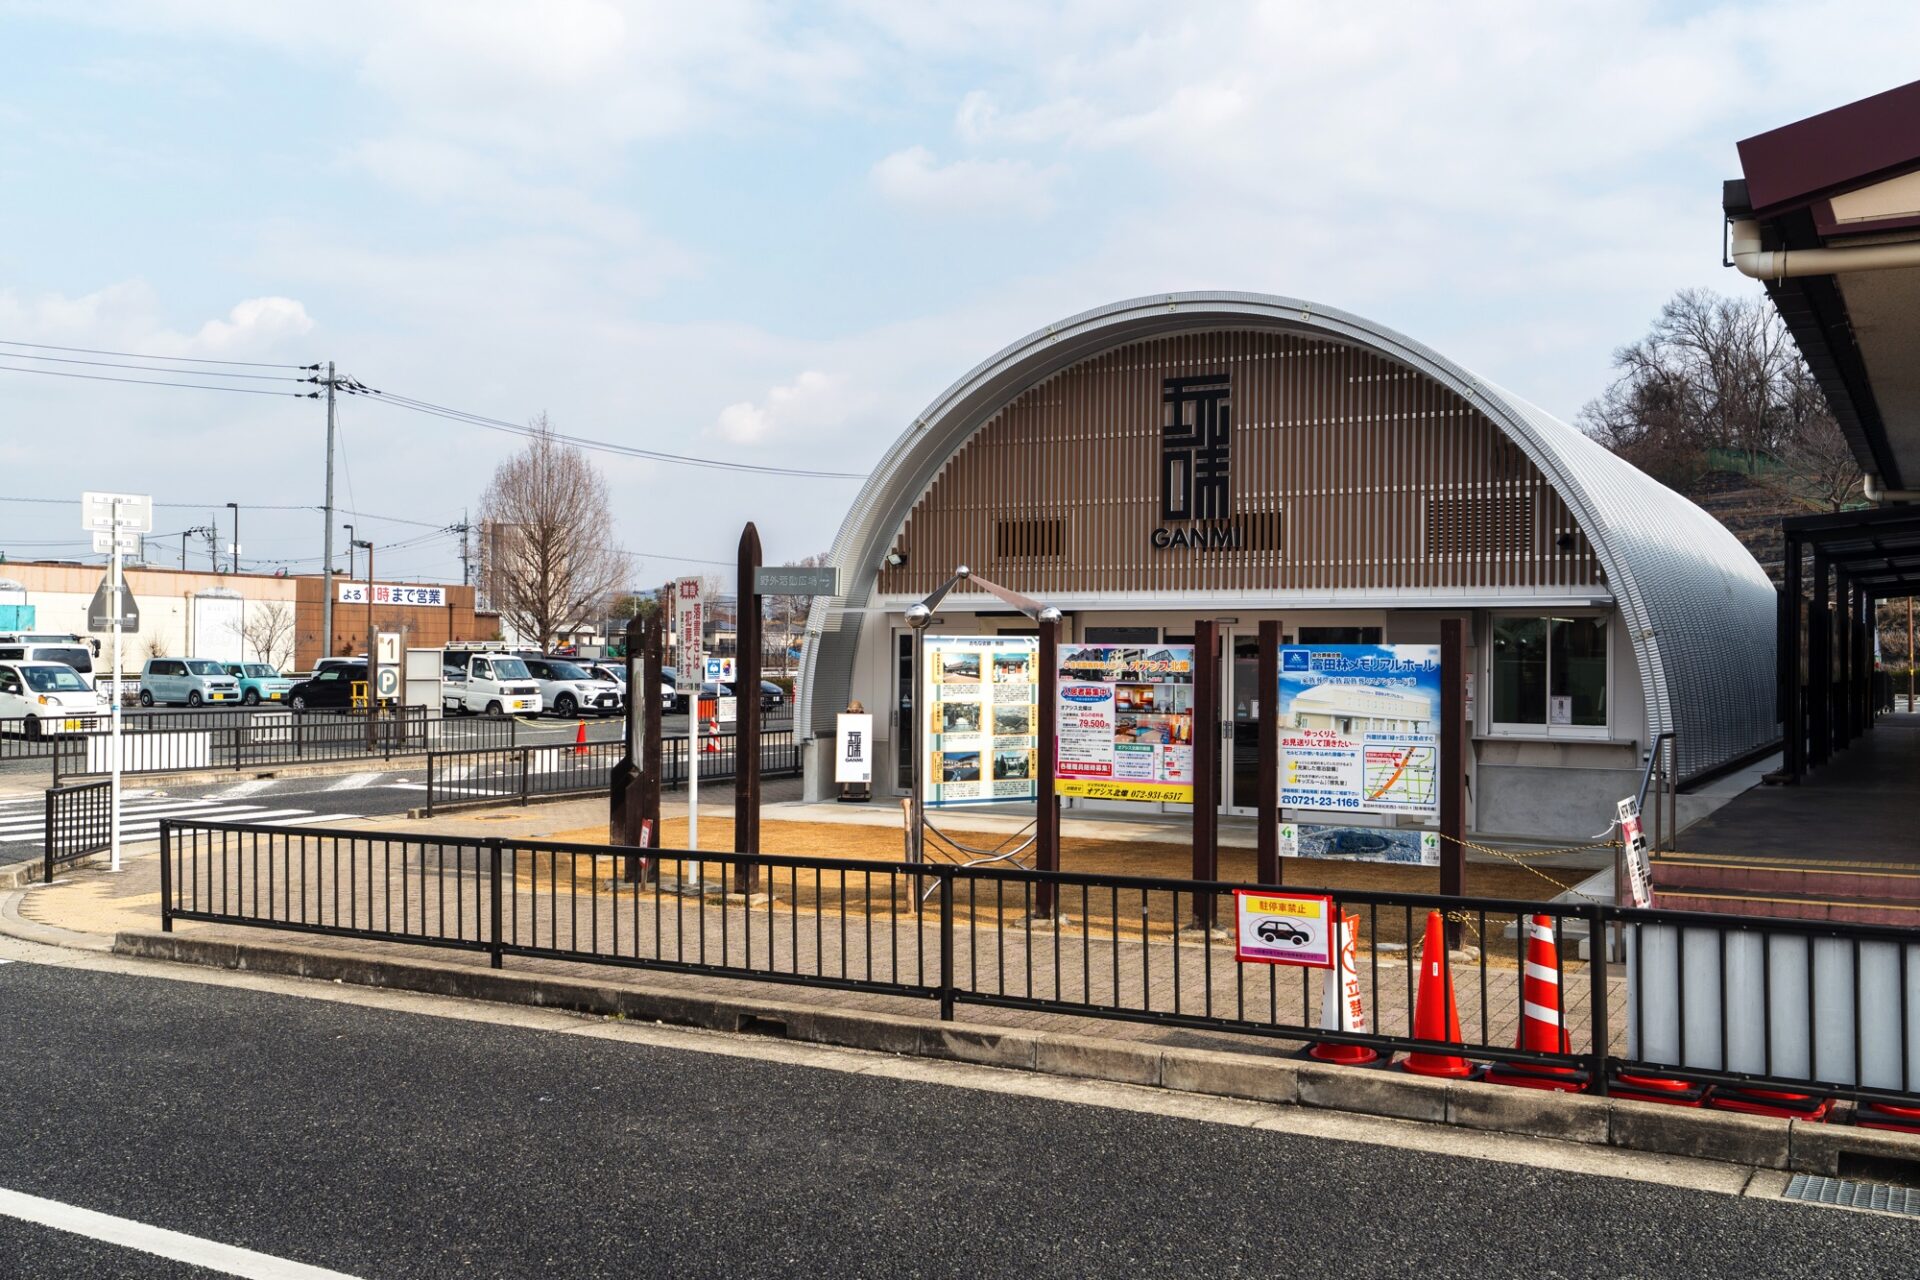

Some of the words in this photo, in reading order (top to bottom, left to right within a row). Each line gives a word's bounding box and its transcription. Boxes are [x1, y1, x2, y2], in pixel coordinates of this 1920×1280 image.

[1151, 527, 1241, 548] GANMI
[693, 603, 702, 670] 落書きは
[387, 638, 393, 659] 1
[1312, 658, 1435, 671] 富田林メモリアルホール
[382, 672, 394, 691] P
[1304, 730, 1336, 738] ゆっくりと
[1131, 790, 1183, 800] 072-931-6517
[1291, 796, 1359, 808] 0721-23-1166
[1259, 900, 1306, 914] 駐停車禁止
